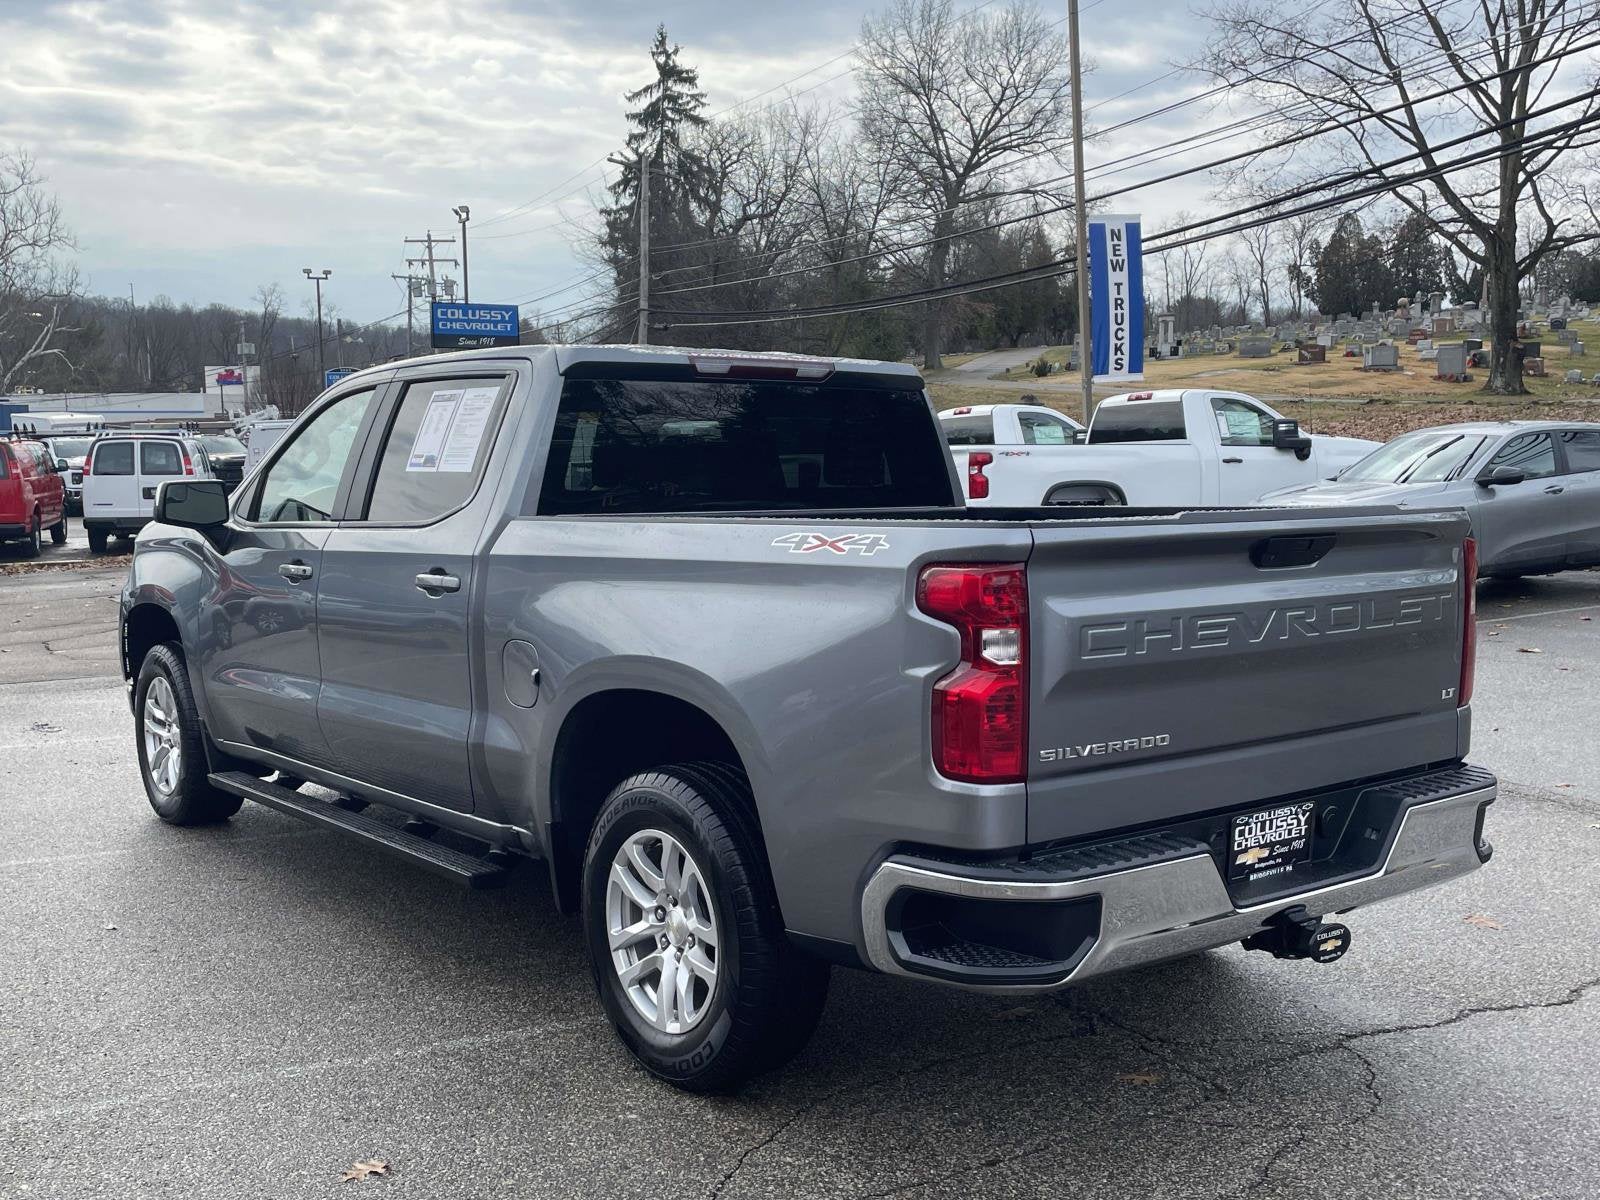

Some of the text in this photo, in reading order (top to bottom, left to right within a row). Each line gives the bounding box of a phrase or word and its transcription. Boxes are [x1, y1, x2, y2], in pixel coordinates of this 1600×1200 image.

[1110, 228, 1125, 371] NEW TRUCKS
[437, 308, 513, 320] COLUSSY
[438, 321, 513, 331] CHEVROLET
[458, 337, 495, 346] Since 1918
[1080, 592, 1452, 660] CHEVROLET
[1441, 687, 1456, 700] LT
[1039, 734, 1171, 762] SILVERADO
[1253, 805, 1298, 822] COLUSSY
[1234, 811, 1310, 841] COLUSSY
[1233, 825, 1308, 851] CHEVROLET
[1272, 838, 1306, 855] Since 1918
[1317, 928, 1345, 941] COLUSSY
